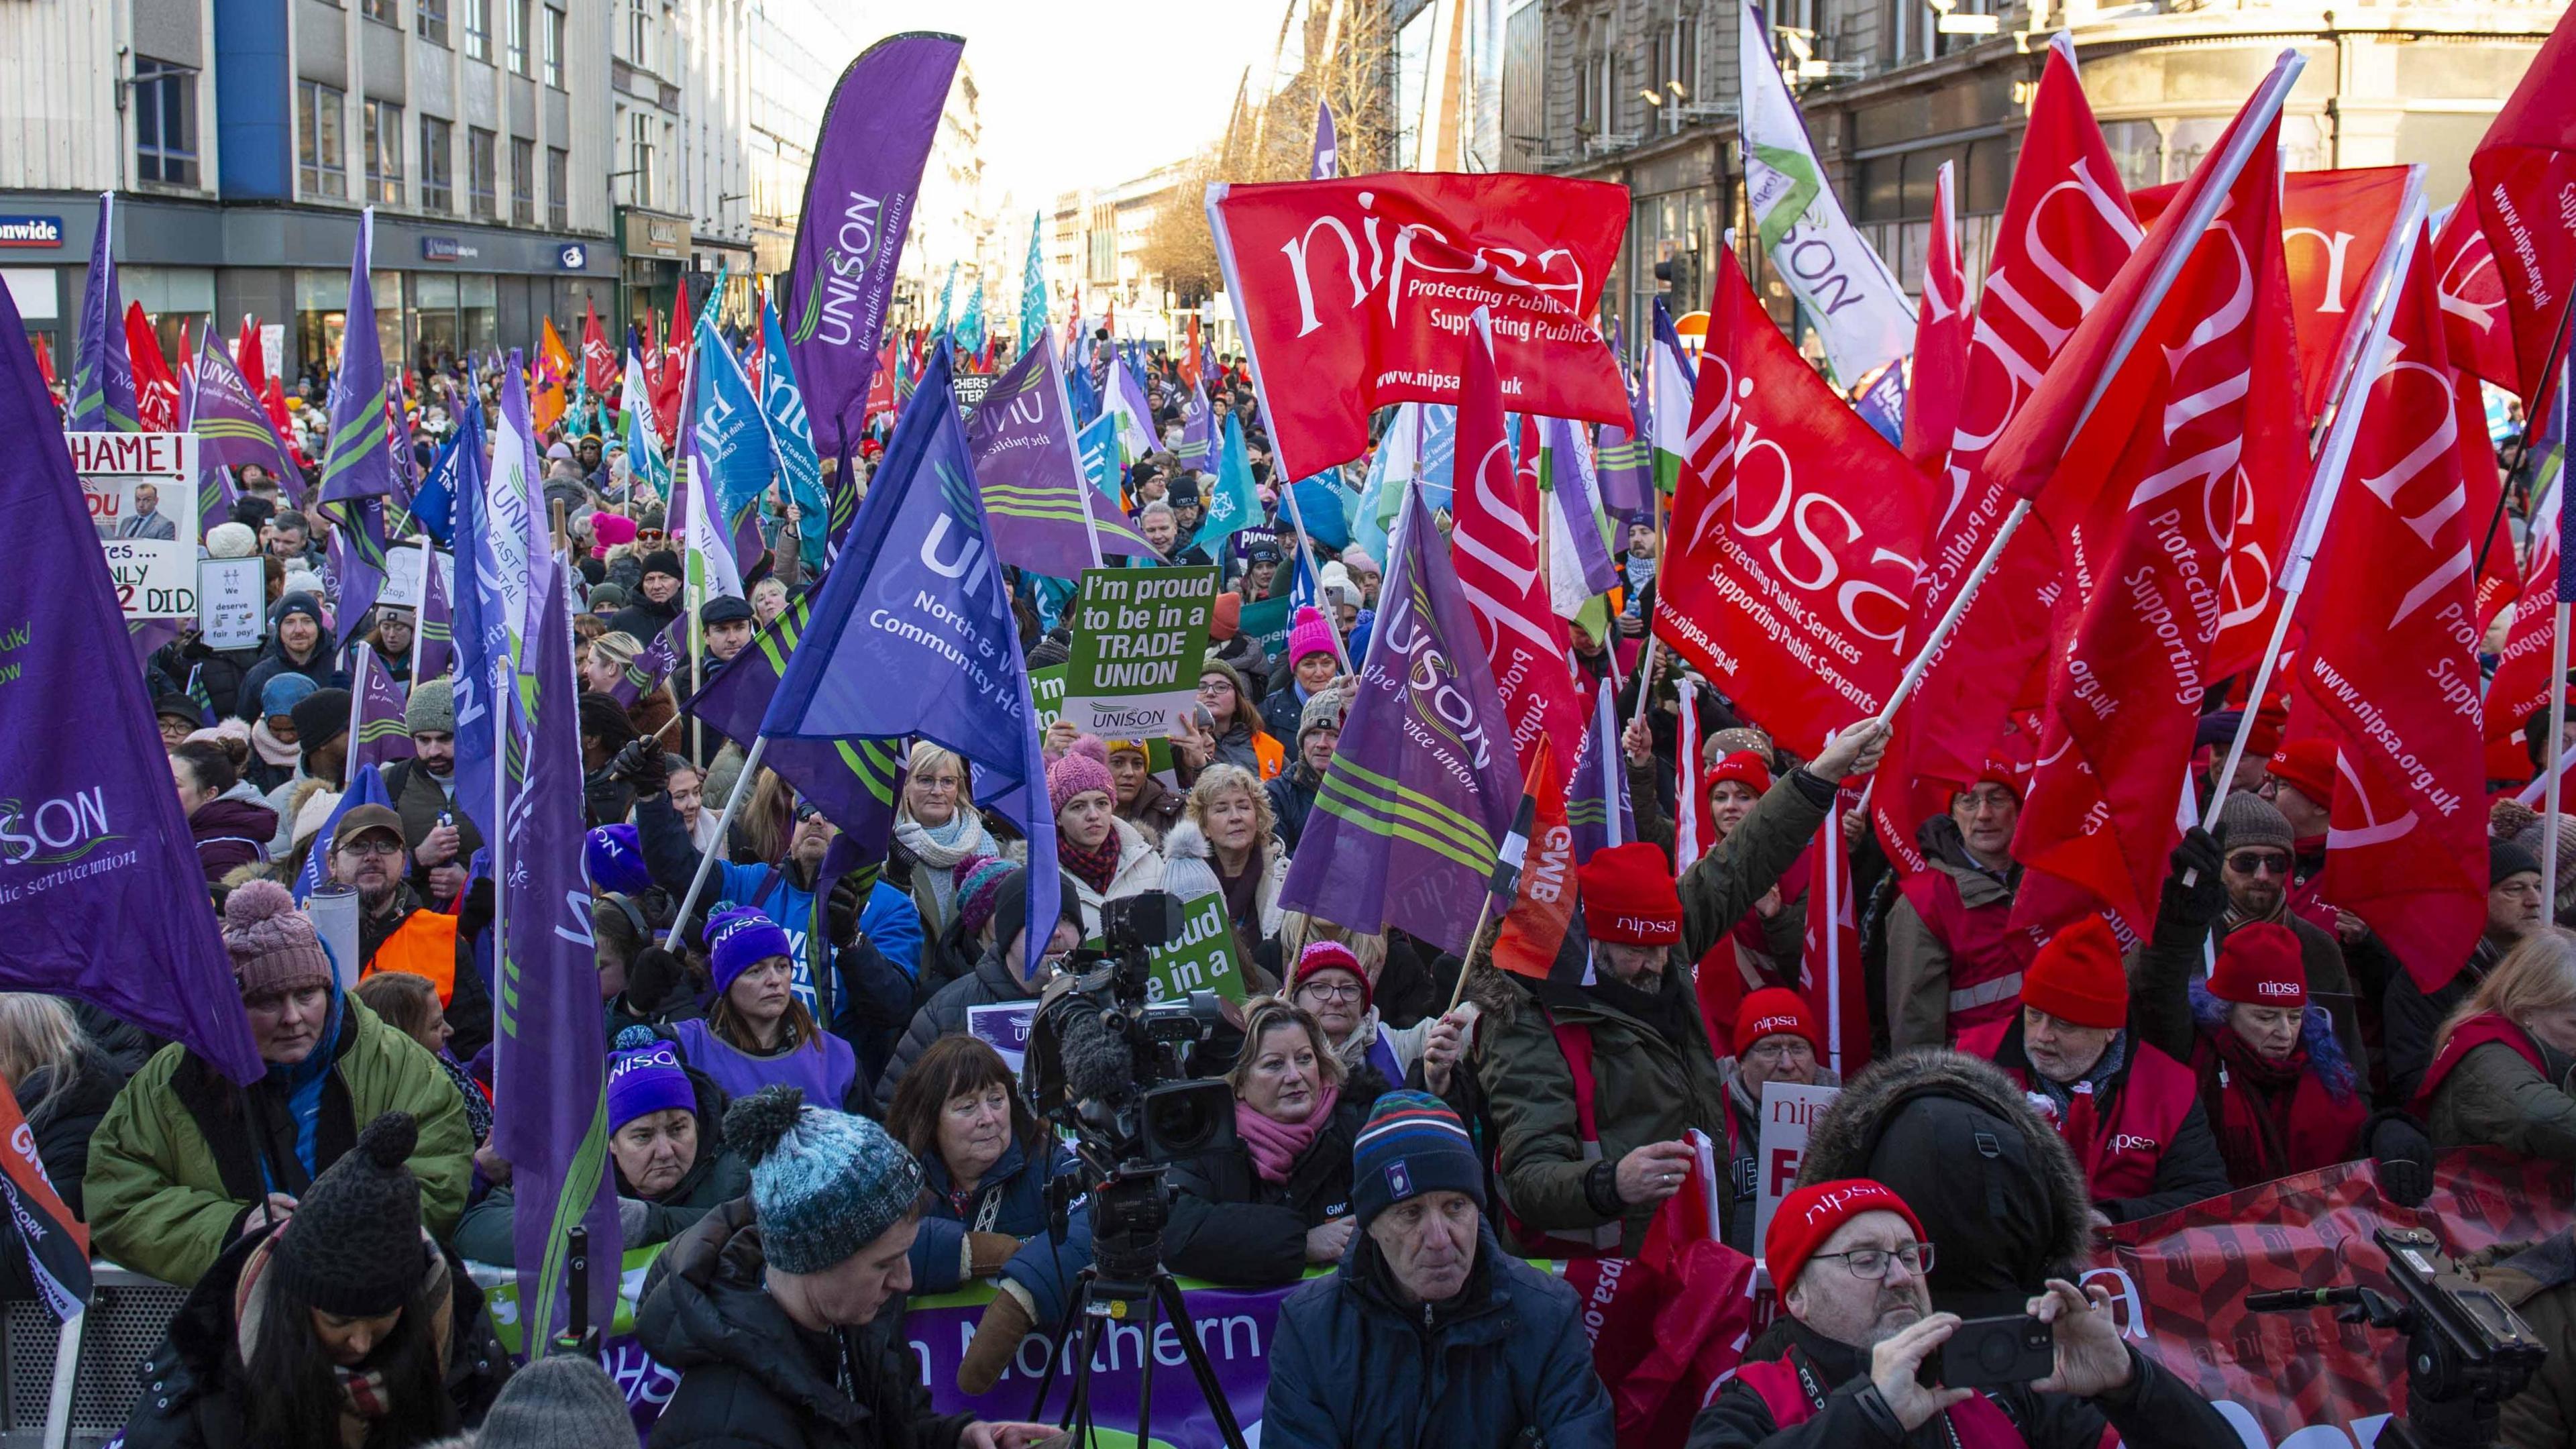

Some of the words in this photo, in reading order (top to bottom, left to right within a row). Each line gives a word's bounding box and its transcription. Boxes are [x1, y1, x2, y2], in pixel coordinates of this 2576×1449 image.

[888, 193, 906, 235] union
[0, 220, 58, 240] nwide
[875, 235, 894, 283] service
[2492, 182, 2553, 311] www.nipsa.org.uk
[818, 191, 880, 347] UNISON
[865, 283, 882, 328] public
[1408, 279, 1503, 309] Protecting
[858, 327, 873, 352] the
[1430, 308, 1530, 343] Suprting
[1534, 320, 1590, 343] Public
[1375, 368, 1523, 395] www.nipsauk
[225, 587, 239, 595] We
[1085, 575, 1129, 601] I'm
[1134, 572, 1215, 604] proud
[2149, 508, 2218, 644] Protecting
[147, 588, 197, 613] DID.
[215, 602, 248, 610] deserve
[1708, 522, 1780, 598] Protecting
[1770, 580, 1806, 622] Public
[1802, 612, 1864, 665] Services
[914, 590, 976, 643] North
[982, 637, 996, 657] &
[1083, 608, 1110, 630] to
[1117, 606, 1151, 630] be
[1157, 604, 1181, 628] in
[1188, 606, 1205, 625] a
[213, 630, 228, 638] fair
[236, 628, 254, 637] pay!
[1095, 631, 1187, 659] TRADE
[1707, 562, 1779, 642] Supporting
[1779, 627, 1816, 672] Public
[1814, 656, 1878, 715] Servants
[2124, 566, 2206, 707] Supporting
[869, 608, 997, 695] Community
[1093, 660, 1178, 688] UNION
[1363, 662, 1397, 692] the
[1093, 709, 1166, 729] UNISON
[2313, 656, 2460, 818] www.nipsa.org.uk
[1435, 741, 1481, 794] union
[27, 863, 89, 897] service
[89, 848, 138, 875] union
[1616, 914, 1676, 938] nipsa
[1169, 958, 1204, 994] in
[1210, 949, 1230, 976] a
[2258, 980, 2300, 996] nipsa
[1754, 1014, 1798, 1033] nipsa
[1326, 1201, 1348, 1216] GM
[1805, 1183, 1888, 1225] nipsa
[1799, 1367, 1819, 1397] EOS
